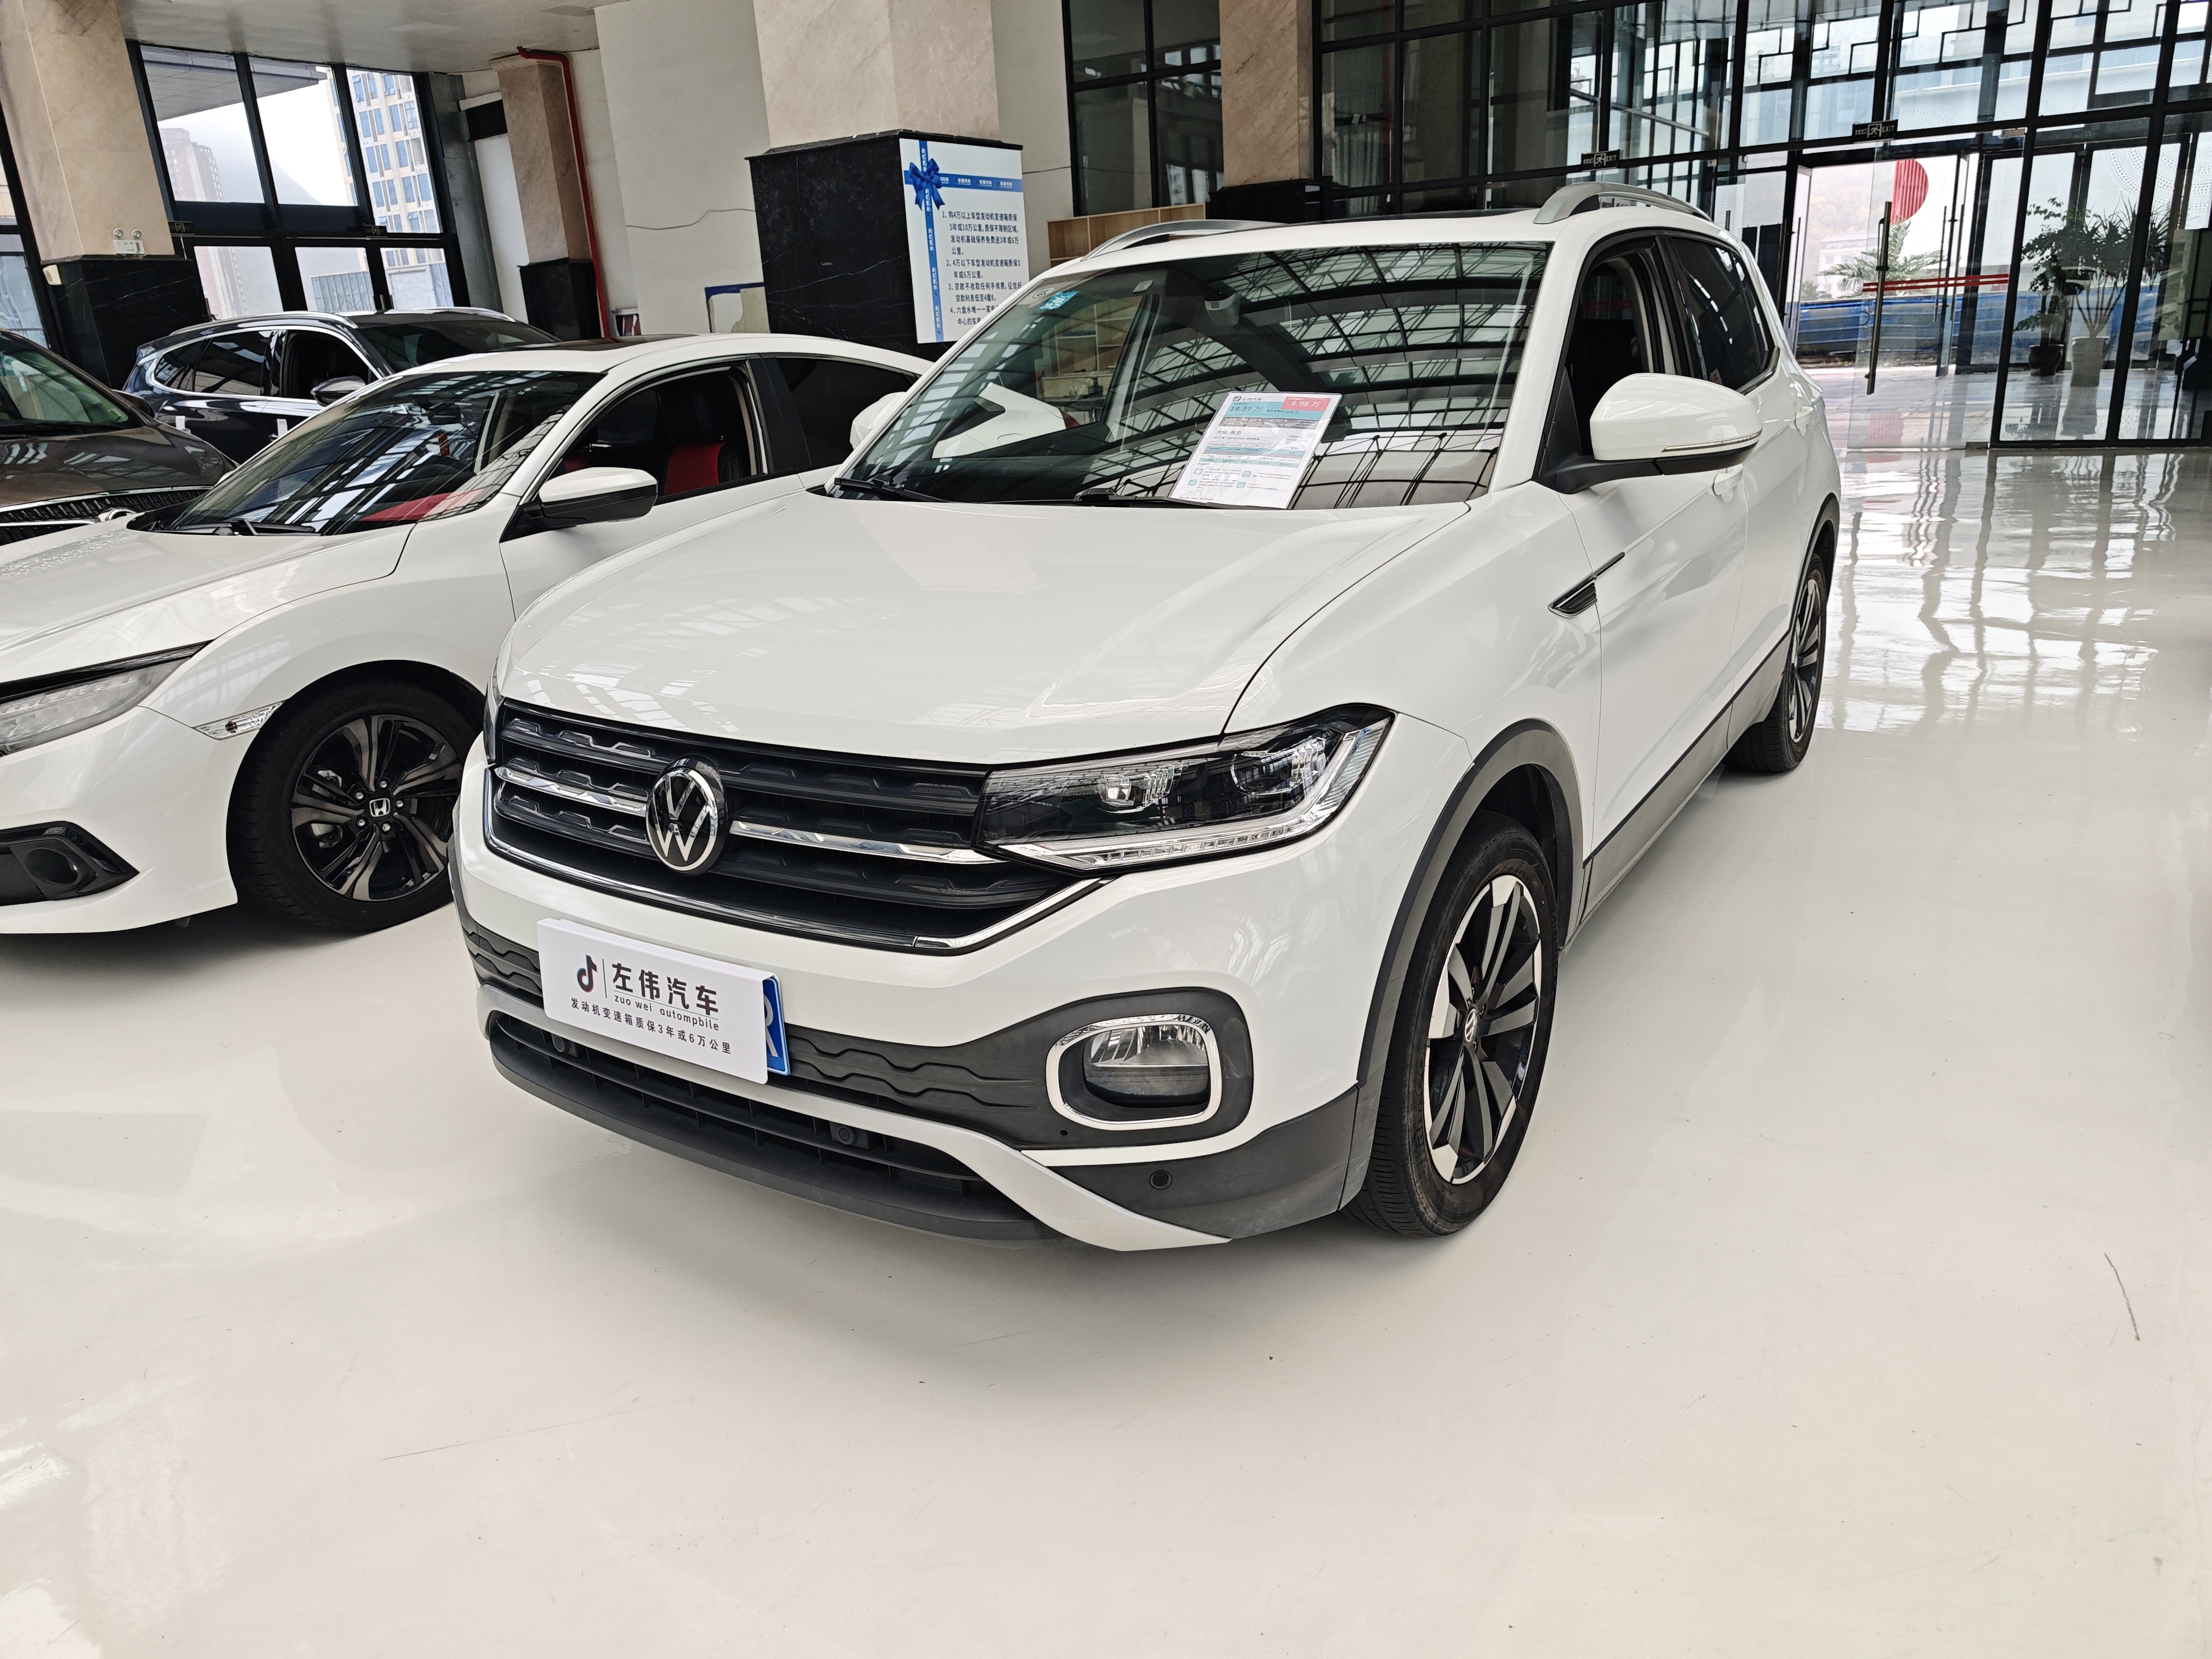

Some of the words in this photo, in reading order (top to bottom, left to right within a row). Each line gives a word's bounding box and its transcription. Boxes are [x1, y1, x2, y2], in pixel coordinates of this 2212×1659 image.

[952, 247, 964, 255] 公里。
[953, 271, 983, 279] 年或6万公里。
[611, 962, 719, 1016] 左伟汽车
[570, 997, 732, 1055] 发动机变速箱质保3年或6万公里
[614, 995, 631, 1006] zuo
[635, 1001, 652, 1013] wei
[659, 1007, 720, 1031] autompbile
